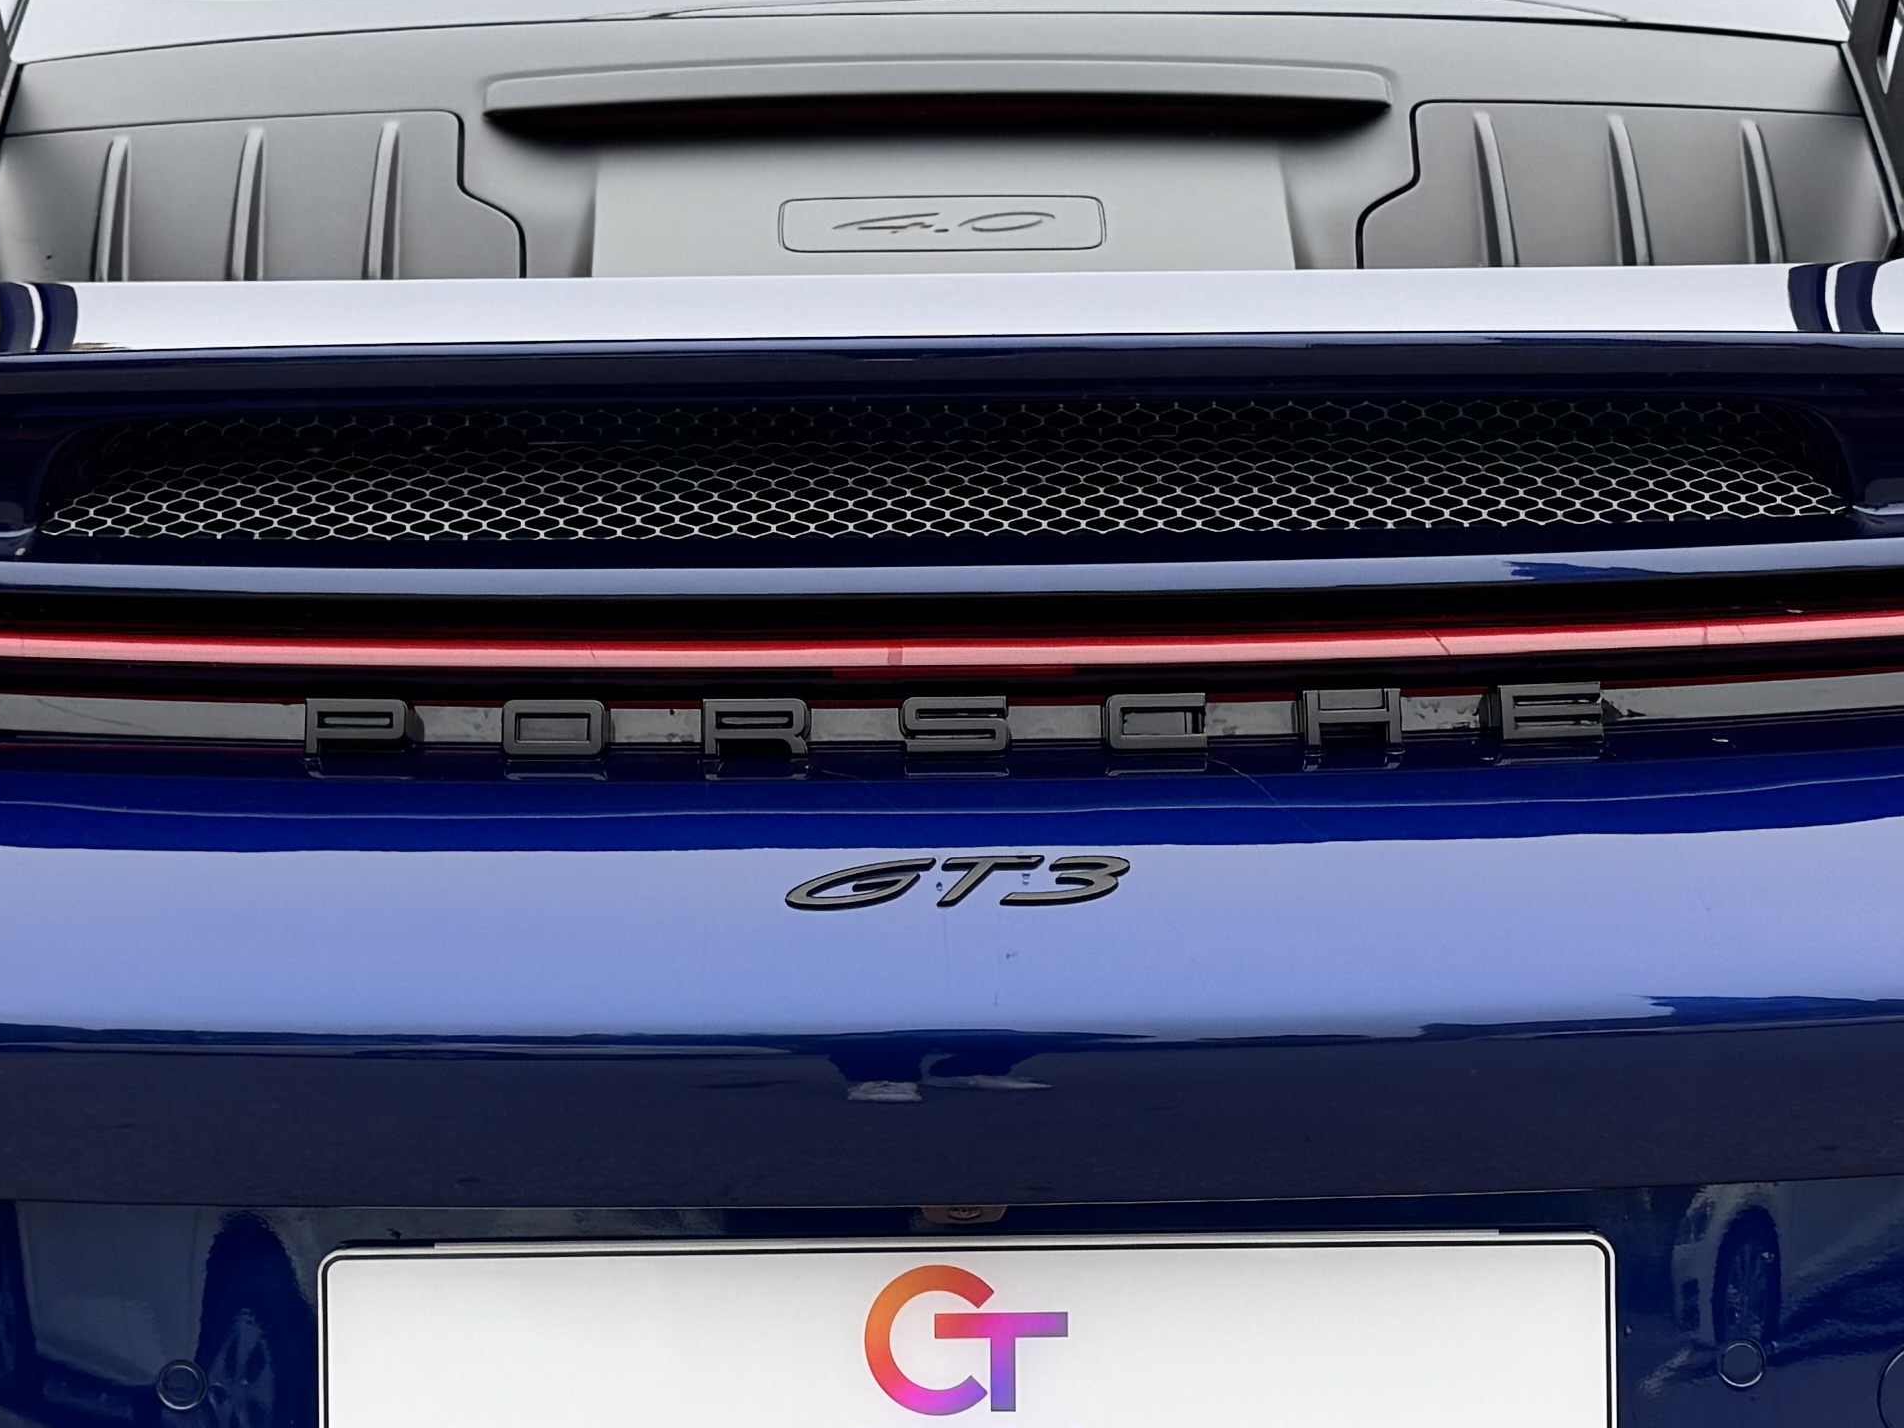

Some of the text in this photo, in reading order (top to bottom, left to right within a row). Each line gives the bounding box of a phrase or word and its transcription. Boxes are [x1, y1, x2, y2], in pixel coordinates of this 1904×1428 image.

[305, 681, 1606, 759] PORSCHE
[784, 854, 1131, 911] GT3
[864, 1264, 1069, 1416] CT
